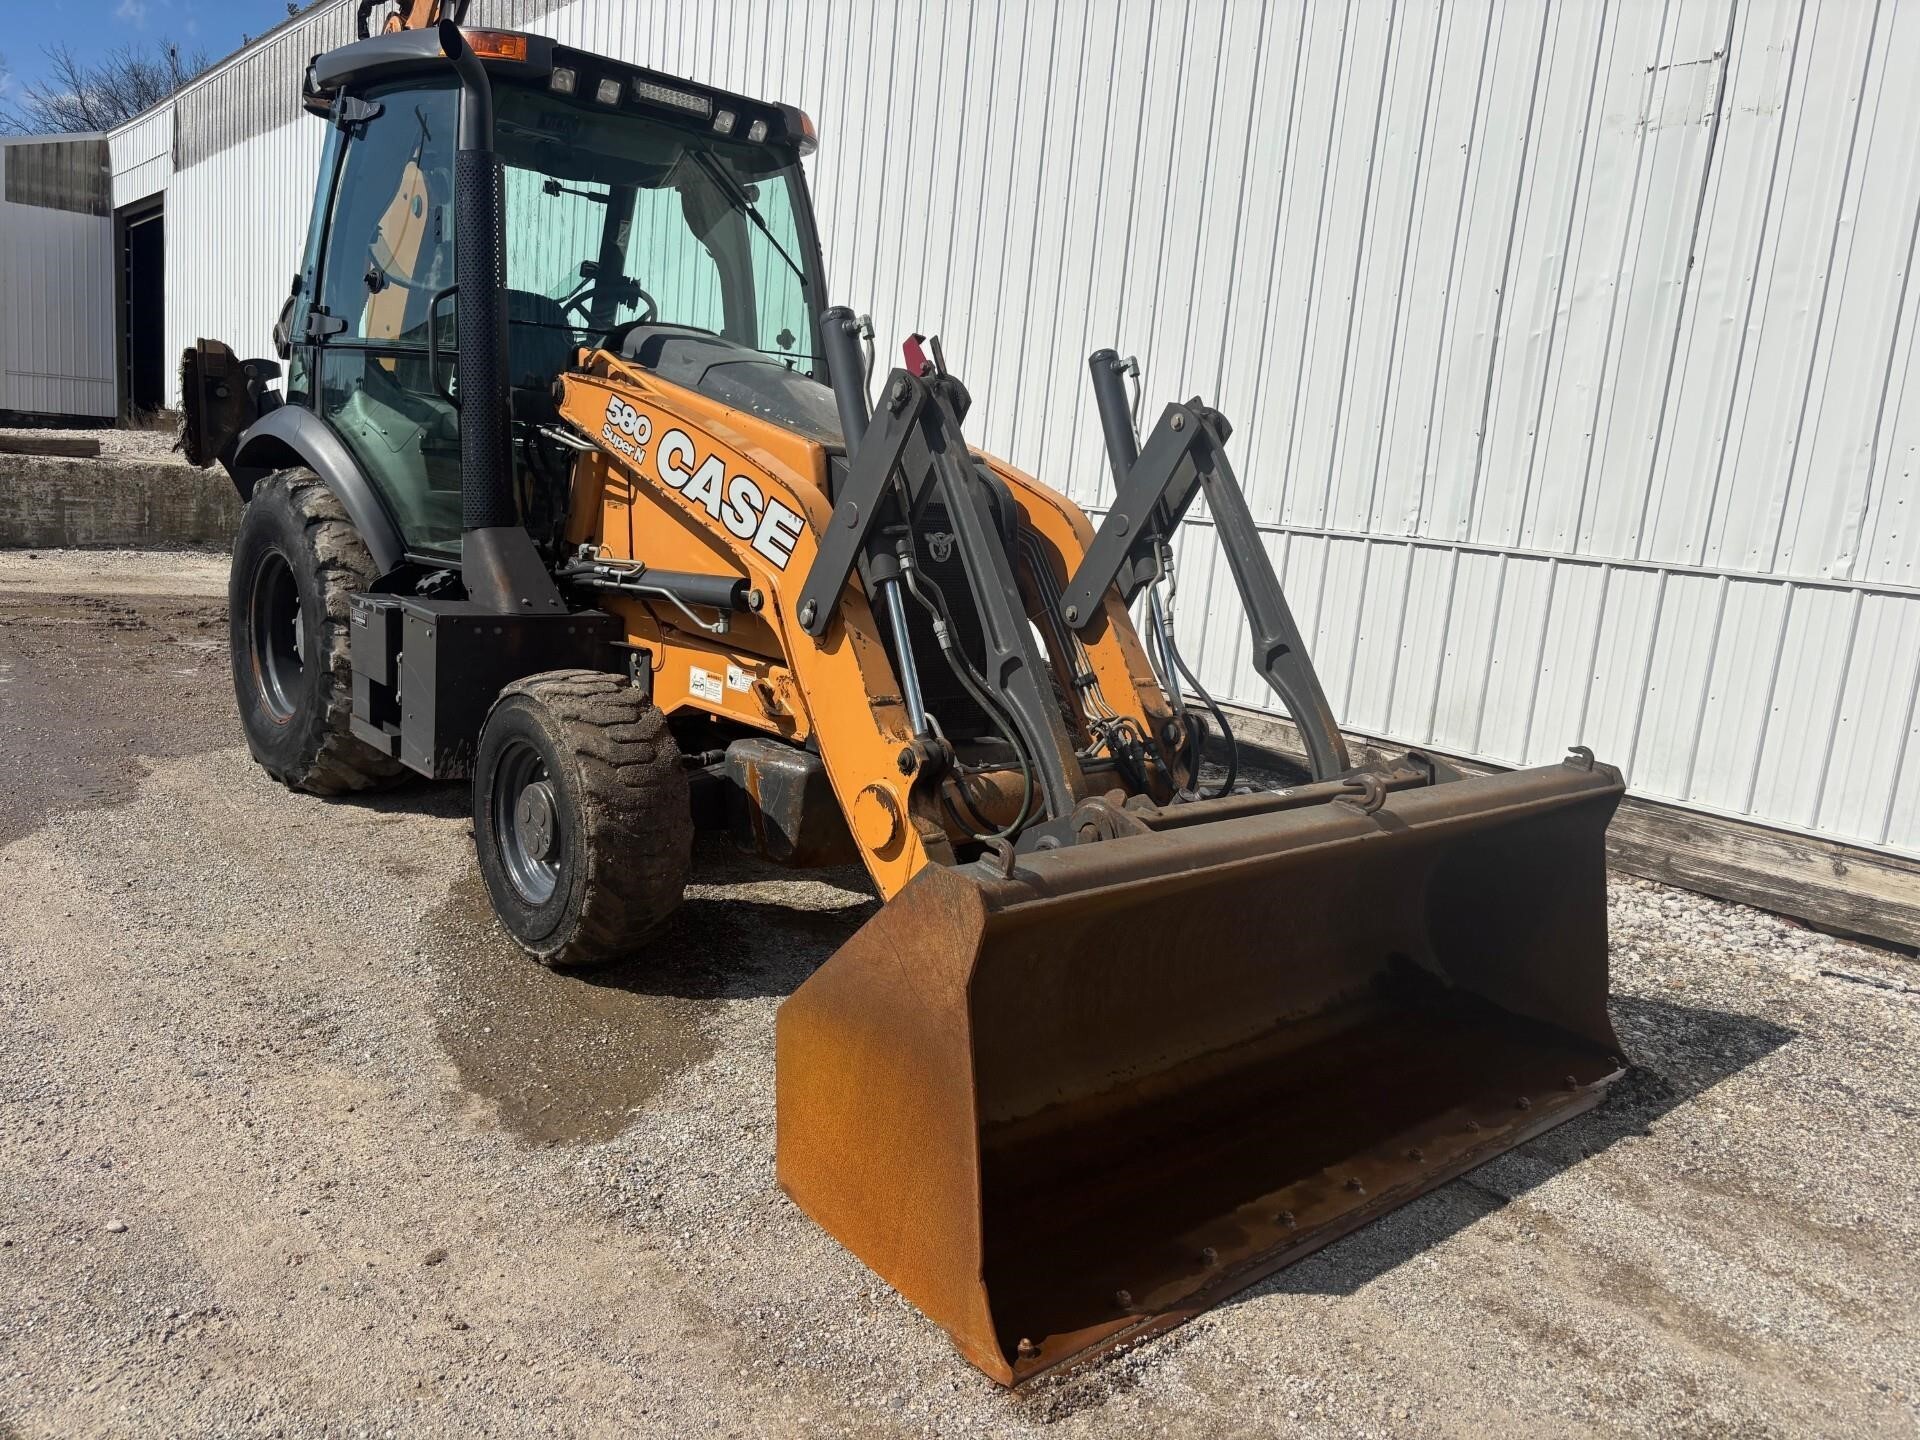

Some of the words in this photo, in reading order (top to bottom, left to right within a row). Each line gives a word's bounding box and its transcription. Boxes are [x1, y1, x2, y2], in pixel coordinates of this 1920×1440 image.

[601, 423, 635, 457] Super
[631, 445, 646, 465] N
[606, 393, 652, 446] 580
[656, 428, 806, 572] CASE
